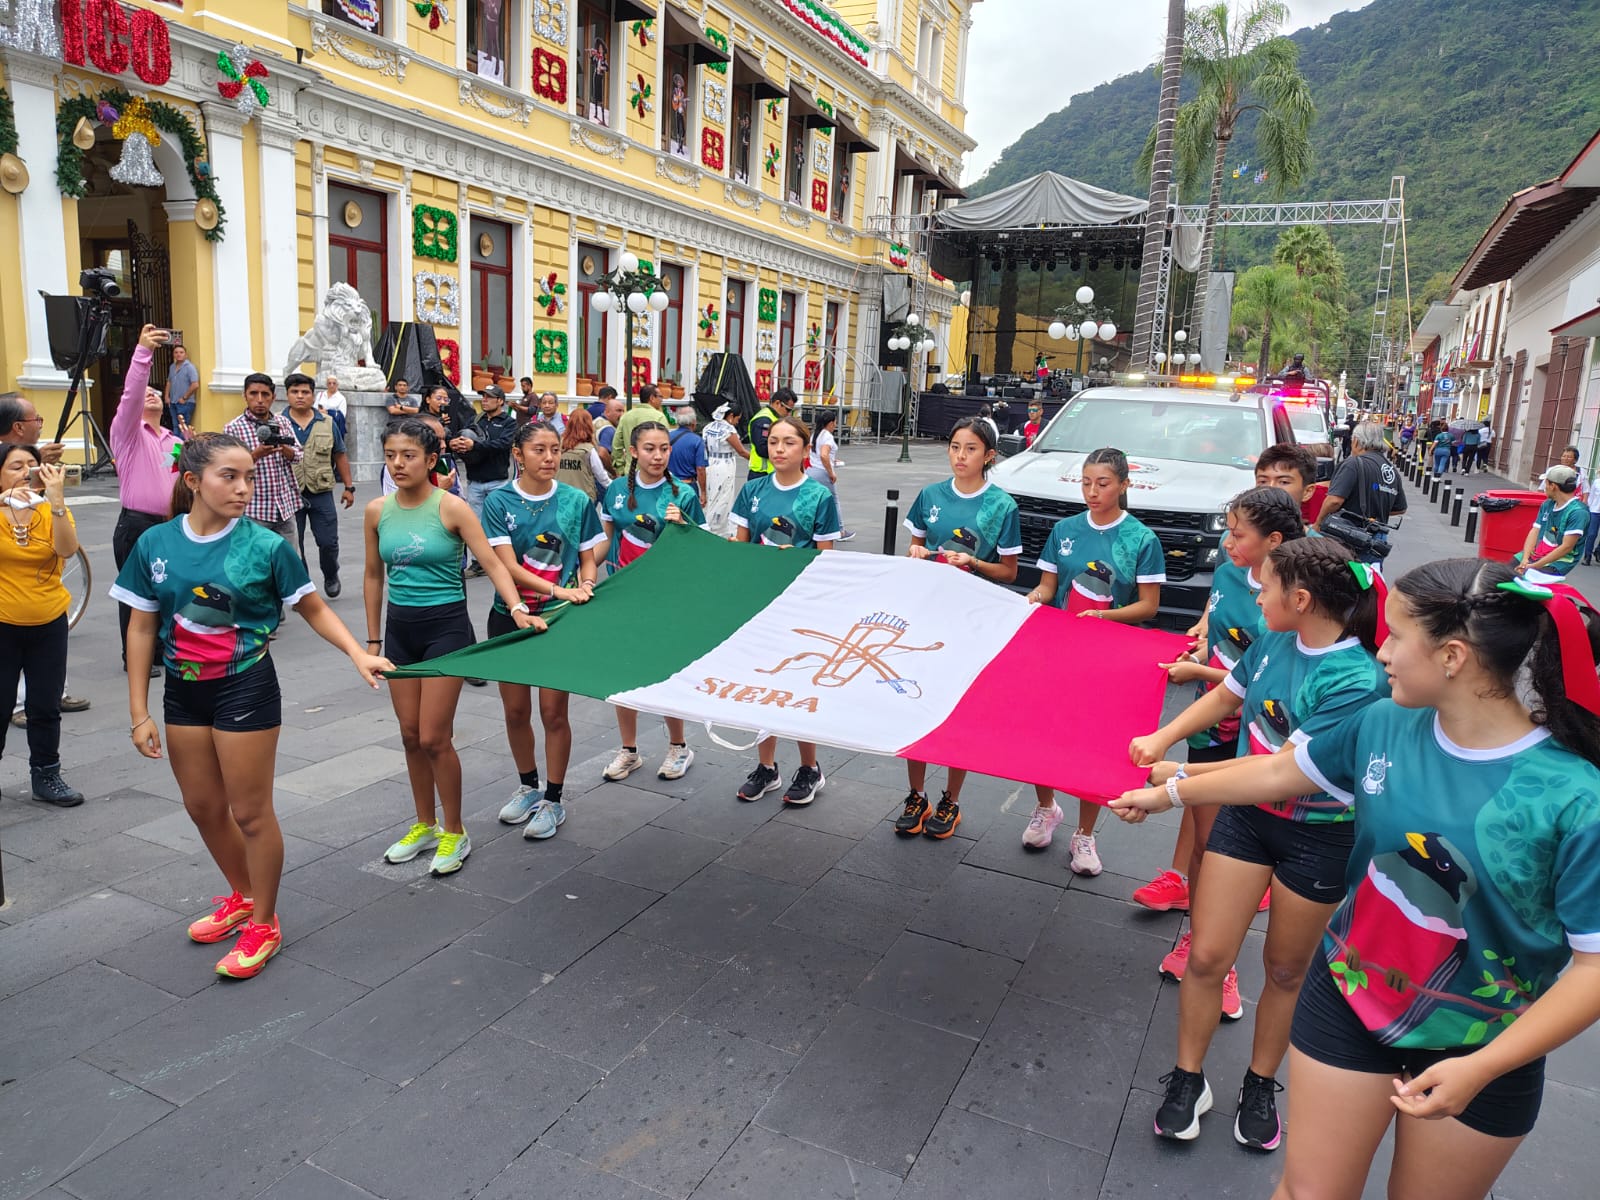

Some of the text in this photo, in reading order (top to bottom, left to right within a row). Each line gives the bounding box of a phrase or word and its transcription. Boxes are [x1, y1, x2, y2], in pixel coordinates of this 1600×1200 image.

[1442, 379, 1451, 389] E
[560, 458, 582, 471] RENSA
[694, 676, 820, 713] SIERA
